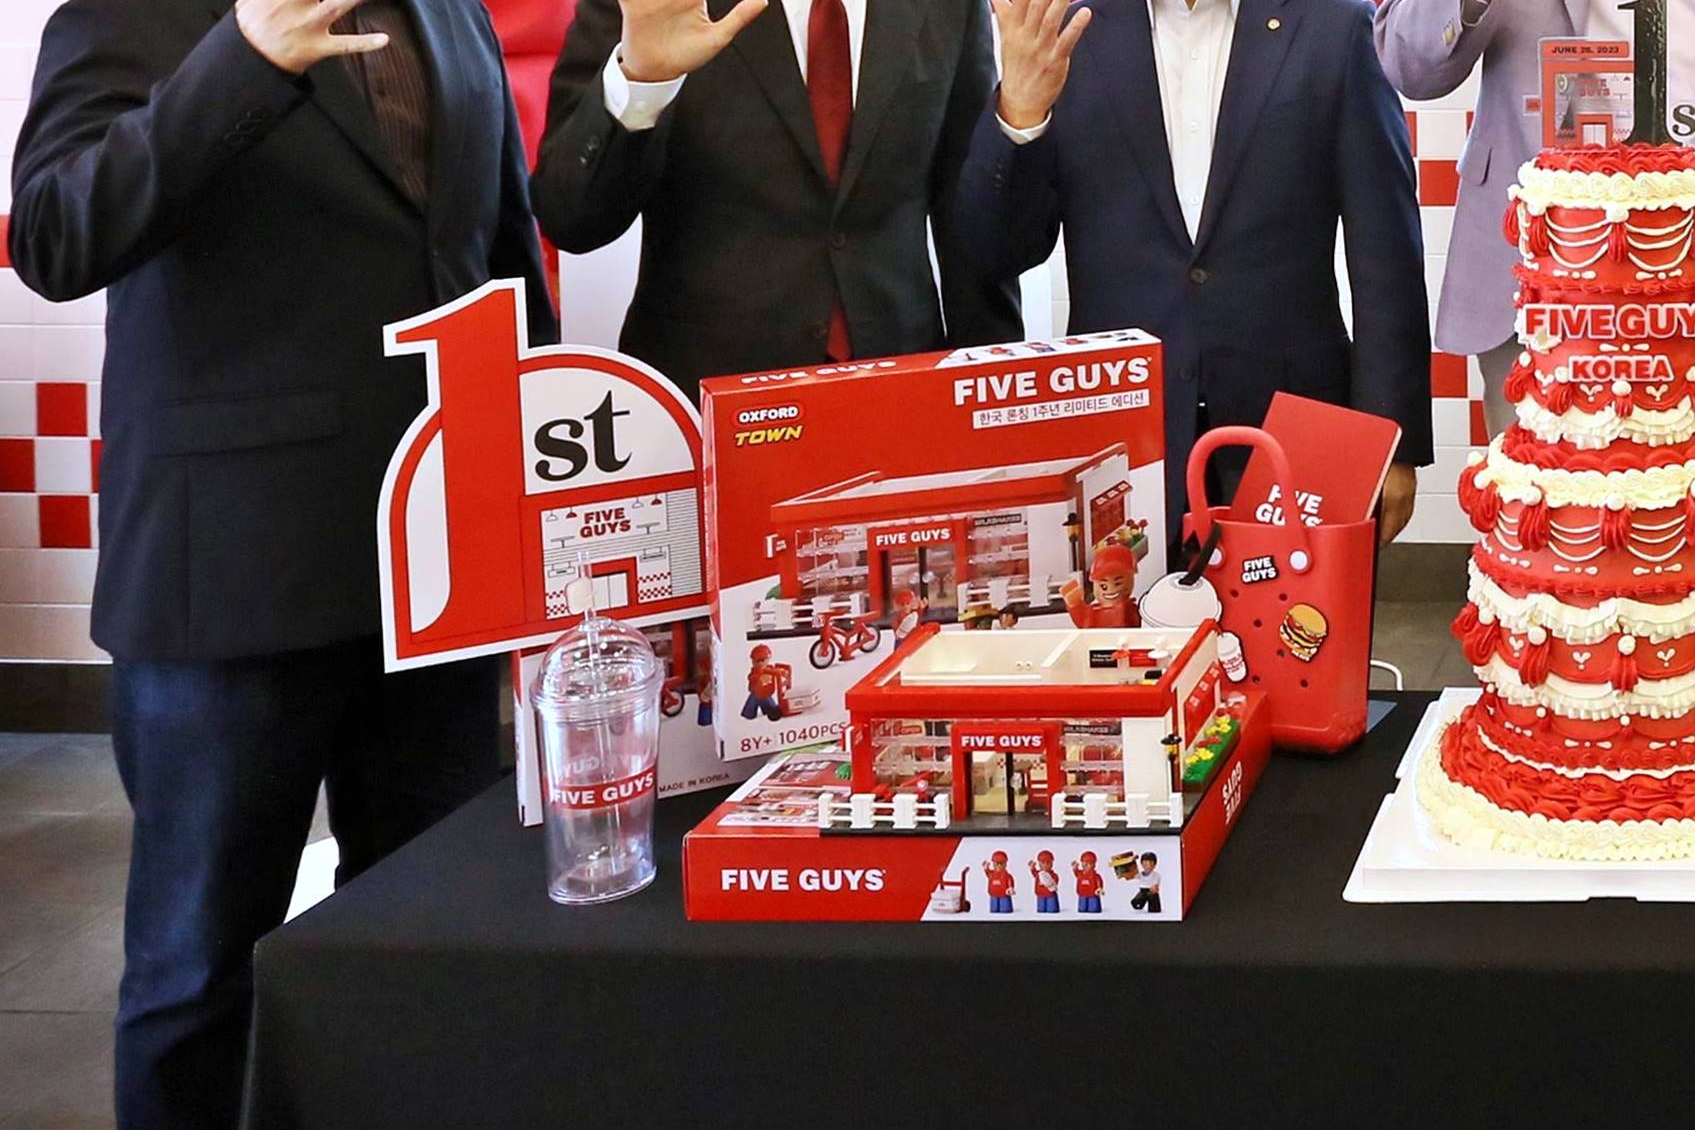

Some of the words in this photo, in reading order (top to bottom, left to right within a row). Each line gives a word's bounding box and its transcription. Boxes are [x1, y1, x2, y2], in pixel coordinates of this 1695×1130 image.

[1525, 306, 1614, 337] FIVE
[1571, 358, 1670, 381] KOREA
[954, 371, 1038, 406] FIVE
[1050, 356, 1150, 393] GUYS
[739, 406, 798, 423] OXFORD
[980, 411, 1003, 426] 한국
[1033, 403, 1060, 418] 1주년
[1064, 398, 1108, 414] 리미티드
[1111, 391, 1144, 407] 에디션
[735, 426, 803, 446] TOWN
[1268, 484, 1323, 515] FVE
[584, 507, 625, 524] FIVE
[1255, 503, 1323, 527] GUS
[580, 520, 631, 538] GUYS
[876, 532, 907, 546] FIVE
[911, 528, 950, 542] GUYS
[1244, 556, 1272, 571] FIVE
[1242, 567, 1277, 583] GUYS
[741, 736, 772, 752] 8Y+
[961, 735, 995, 747] FIVE
[999, 735, 1042, 747] GUYS
[551, 789, 596, 806] FIVE
[602, 773, 654, 802] GUYS
[660, 782, 685, 792] MADE
[688, 779, 698, 787] IN
[700, 772, 731, 786] KOREA
[721, 869, 790, 891] FIVE
[799, 869, 884, 891] GUYS
